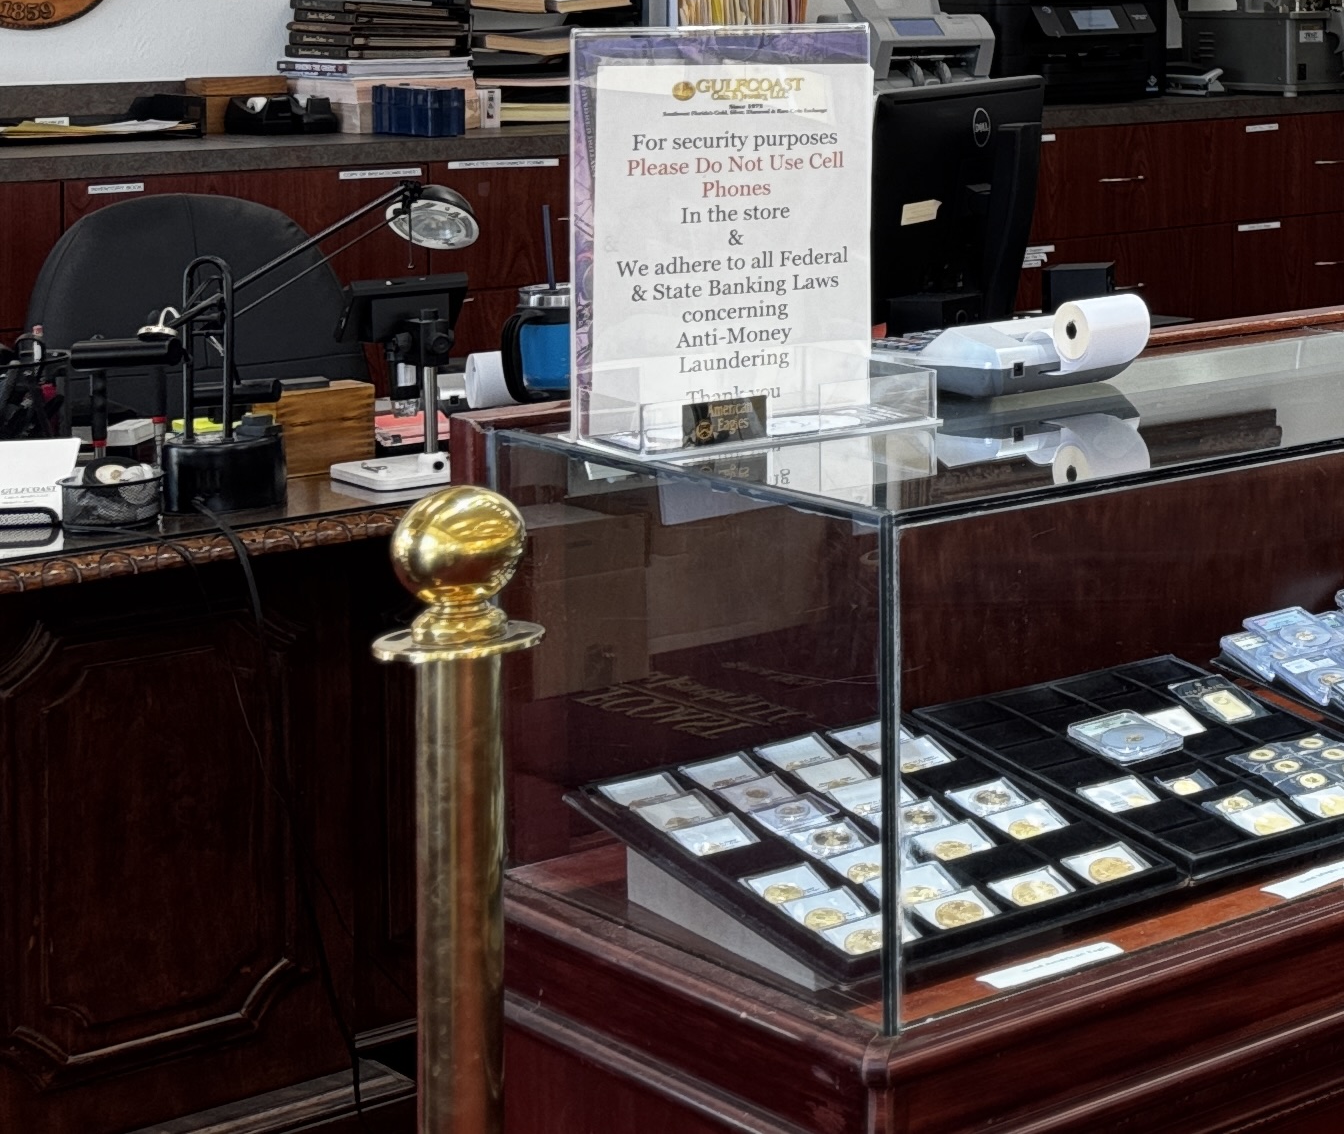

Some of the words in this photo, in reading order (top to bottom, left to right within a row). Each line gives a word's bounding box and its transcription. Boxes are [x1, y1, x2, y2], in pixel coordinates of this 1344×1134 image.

[0, 0, 56, 21] 1859
[695, 77, 805, 94] GULFCOAST
[632, 134, 667, 151] For
[672, 131, 749, 153] security
[753, 130, 838, 151] purposes
[627, 159, 689, 177] Please
[695, 157, 722, 175] Do
[728, 155, 764, 173] Not
[770, 154, 804, 172] Use
[809, 151, 844, 169] Cell
[702, 180, 771, 198] Phones
[681, 207, 704, 224] In
[707, 204, 738, 222] the
[743, 204, 790, 222] store
[728, 229, 744, 246] &
[616, 260, 649, 278] We
[654, 256, 721, 275] adhere
[726, 255, 746, 271] to
[751, 251, 774, 269] all
[780, 246, 849, 267] Federal
[631, 285, 648, 302] &
[652, 282, 703, 301] State
[708, 276, 787, 298] Banking
[791, 273, 840, 292] Laws
[682, 299, 789, 324] concerning
[676, 325, 793, 349] Anti-Money
[678, 350, 790, 374] Laundering
[707, 402, 752, 417] American
[717, 416, 750, 434] Eagles
